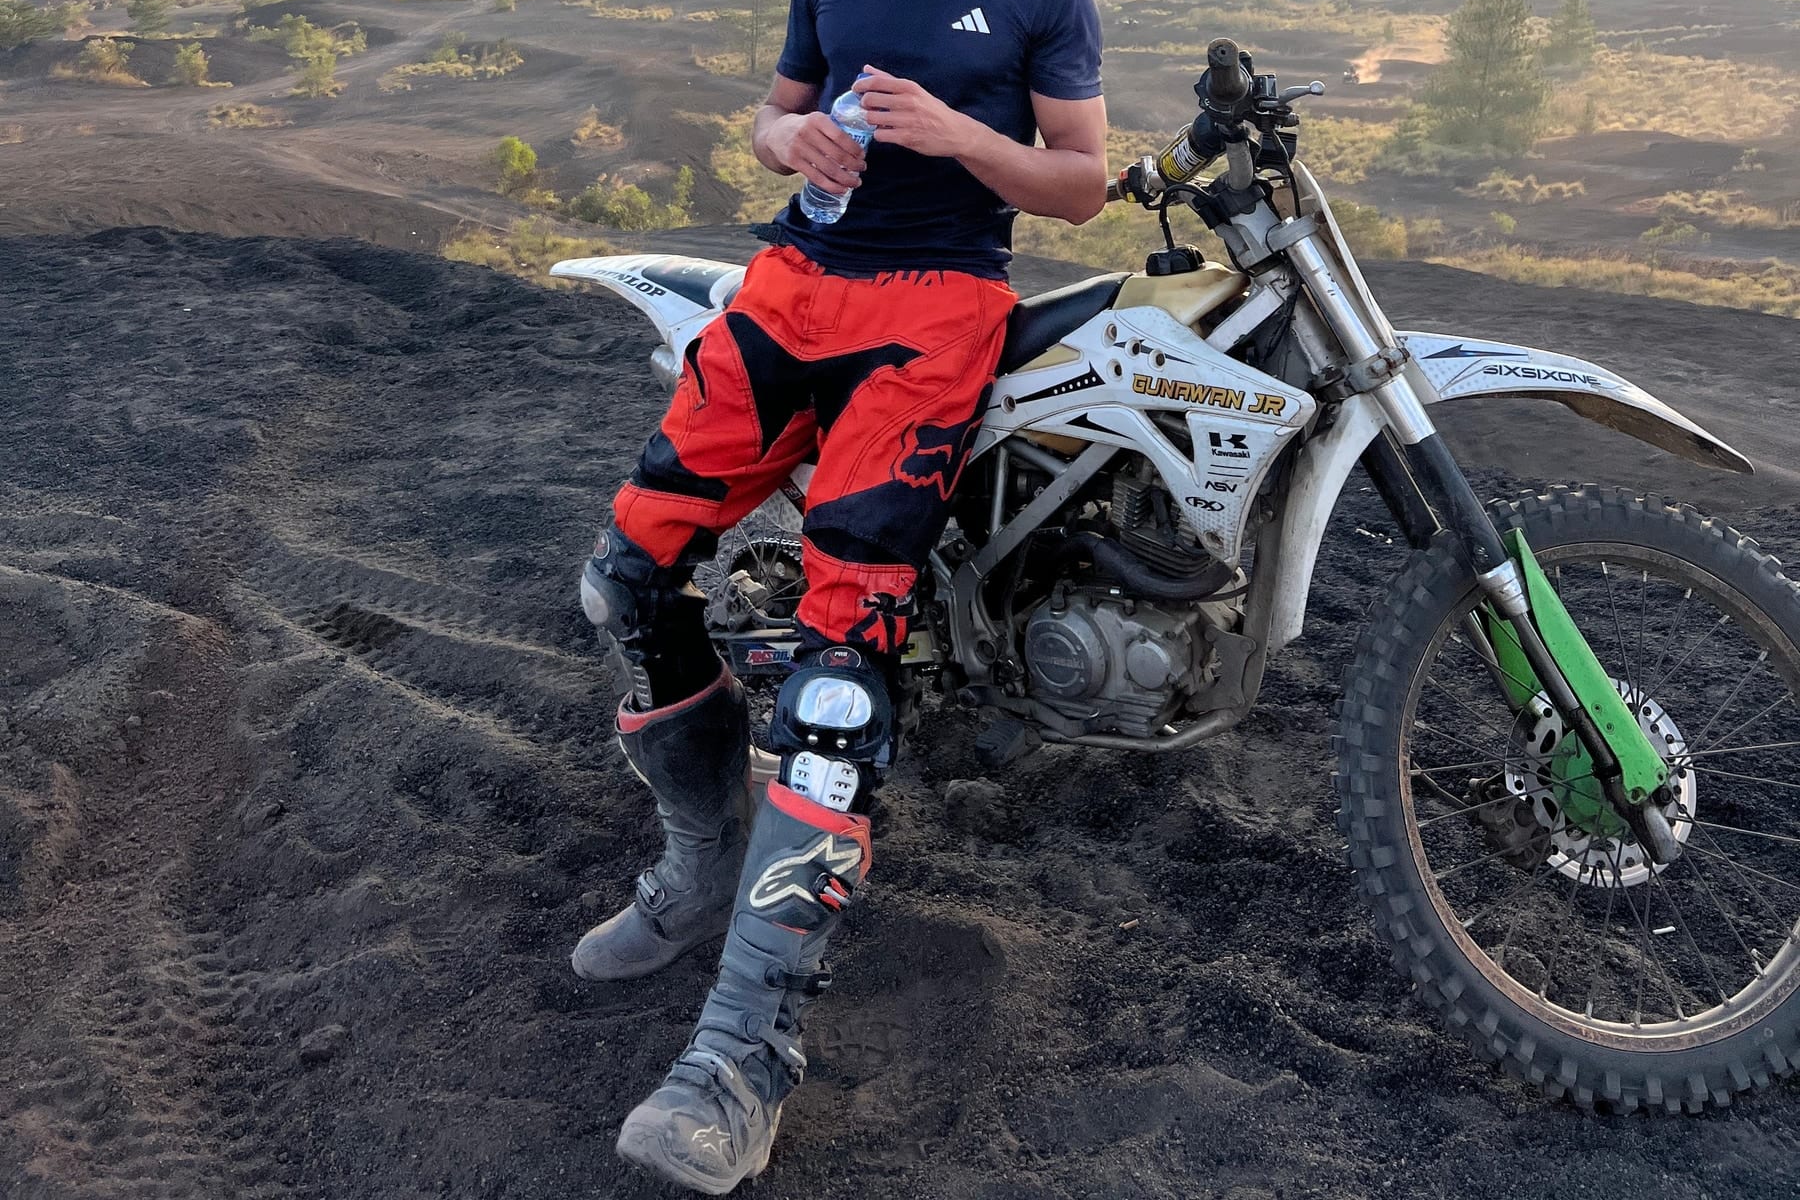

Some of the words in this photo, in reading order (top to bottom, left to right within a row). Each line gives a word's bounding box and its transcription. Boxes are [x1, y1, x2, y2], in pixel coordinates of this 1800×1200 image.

[1483, 364, 1602, 386] SIXSIXONE
[1132, 373, 1246, 411] GUNAWAN
[1248, 392, 1286, 417] JR
[1211, 448, 1251, 459] Kawasaki
[1204, 480, 1238, 493] ASV
